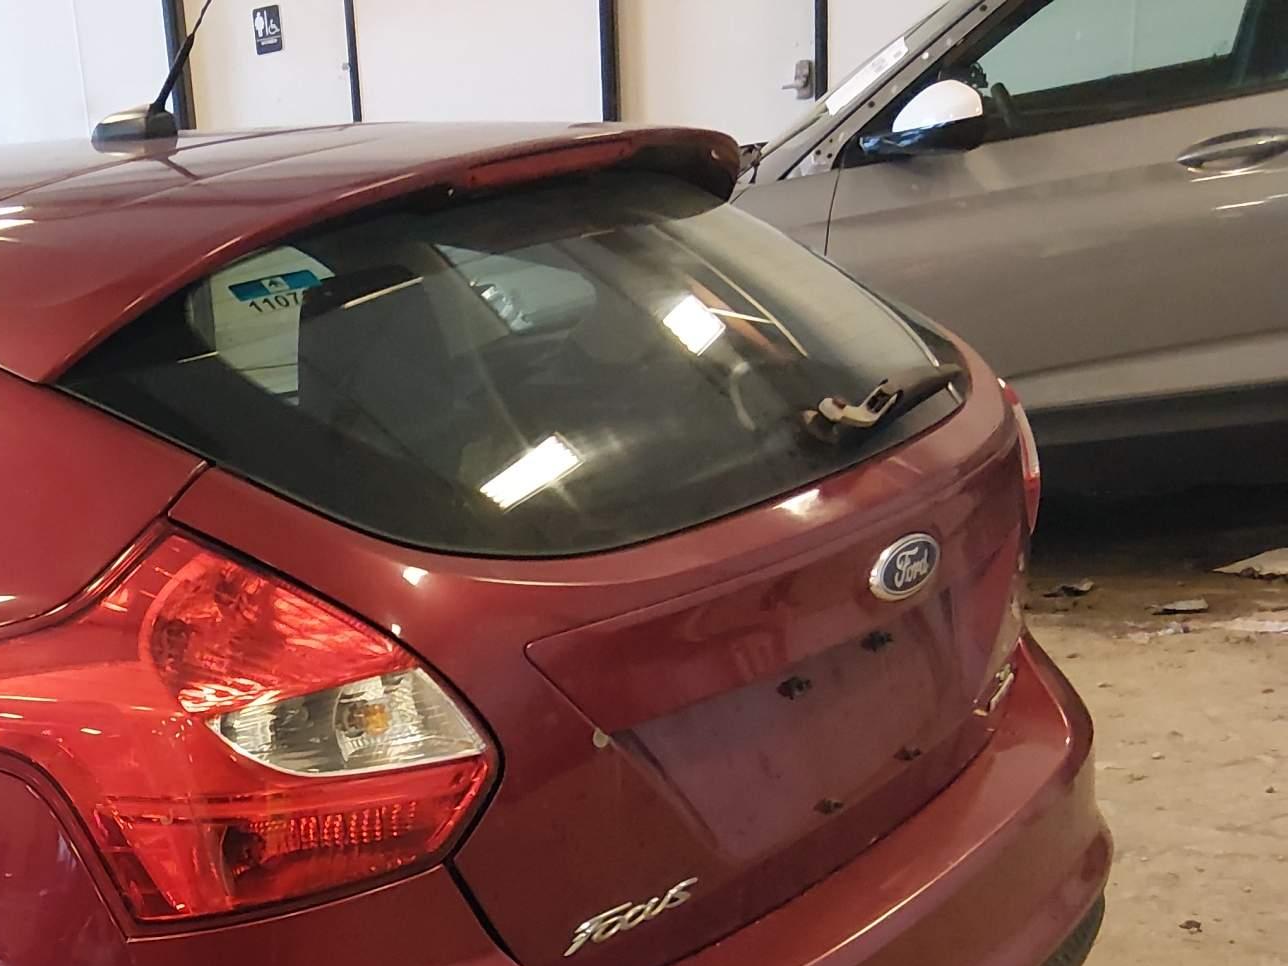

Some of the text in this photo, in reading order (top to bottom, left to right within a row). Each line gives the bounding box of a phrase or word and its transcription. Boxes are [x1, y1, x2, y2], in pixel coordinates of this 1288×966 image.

[249, 291, 305, 313] 1107
[894, 546, 930, 588] Ford
[563, 877, 699, 957] Focus
